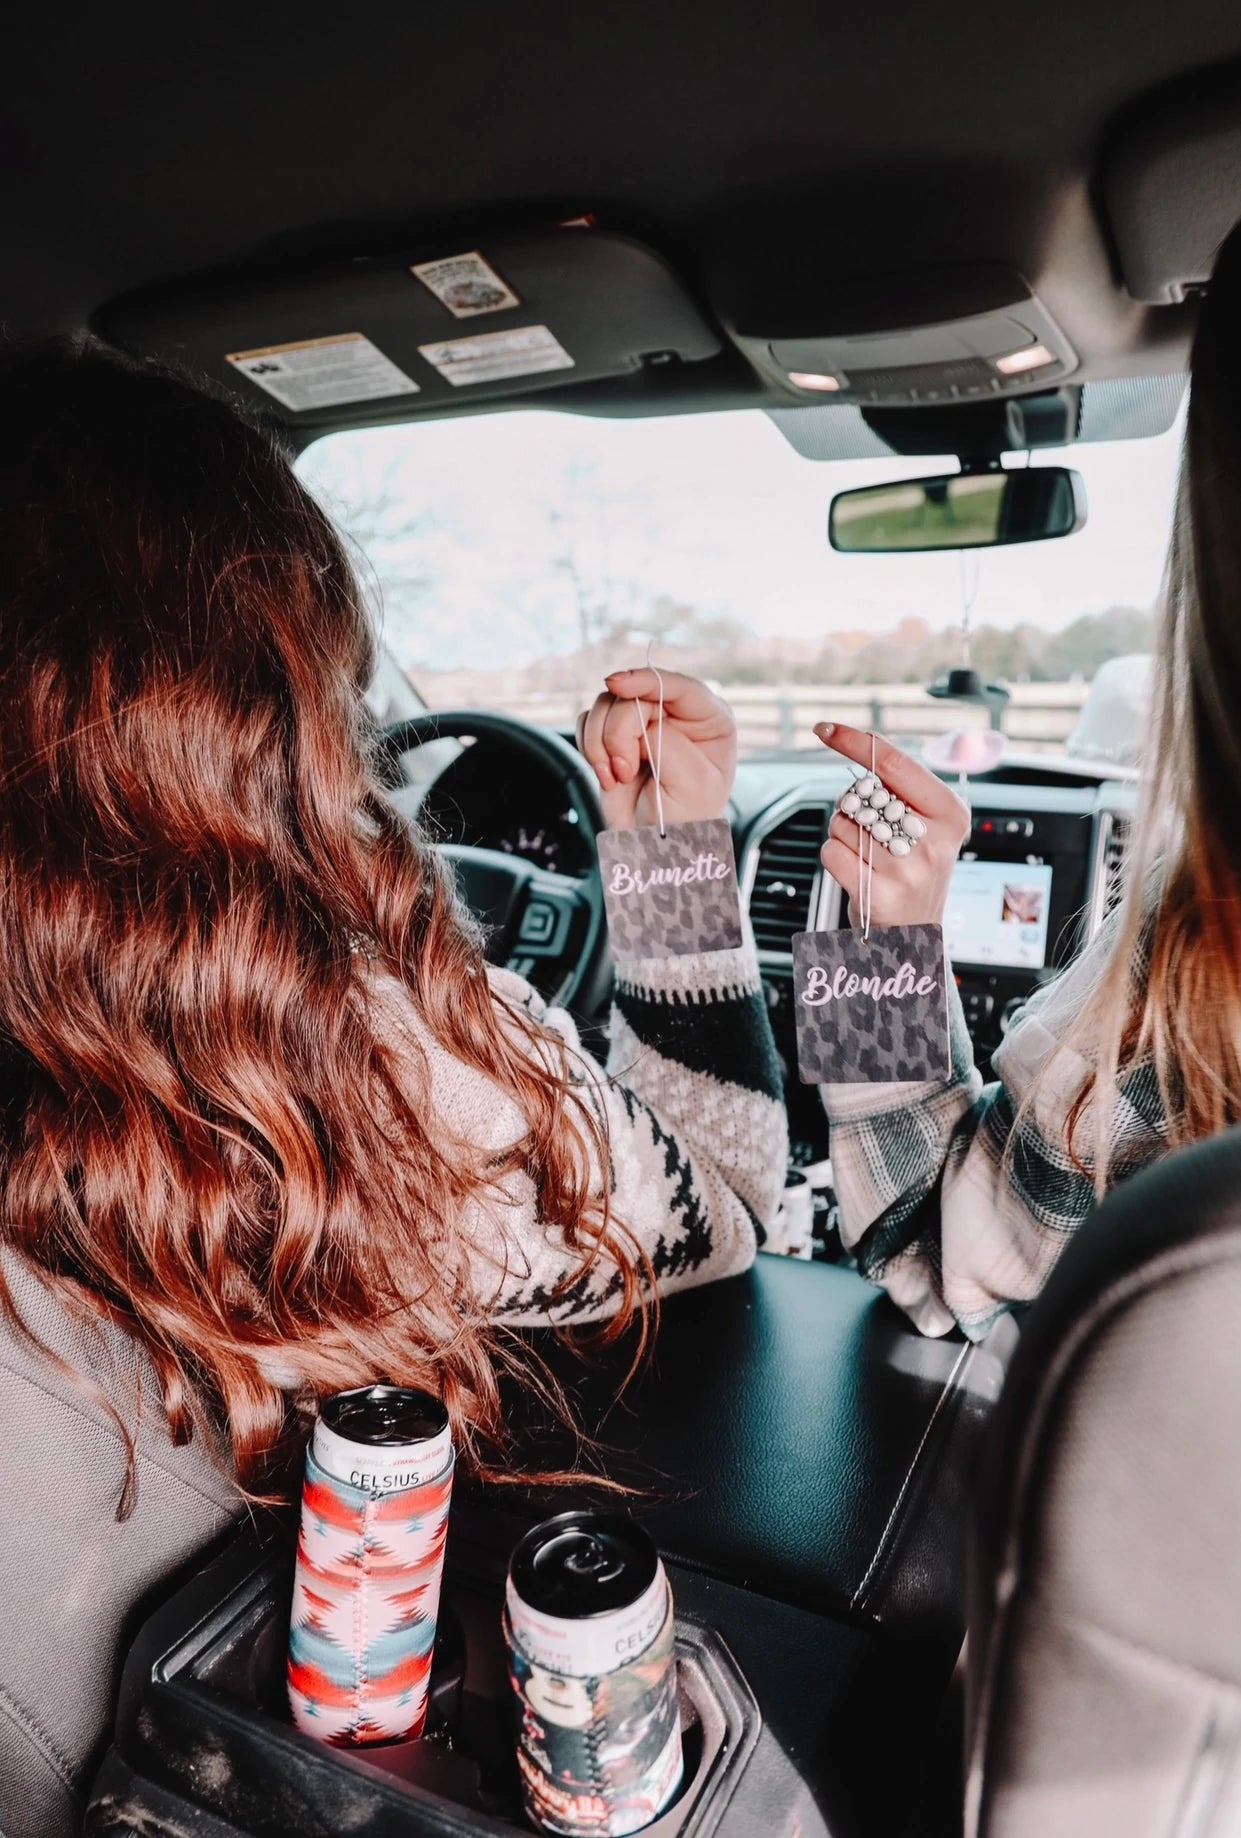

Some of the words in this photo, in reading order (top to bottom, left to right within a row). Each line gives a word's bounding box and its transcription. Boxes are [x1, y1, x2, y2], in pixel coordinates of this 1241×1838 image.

[609, 853, 732, 895] Brunette
[801, 962, 938, 1006] Blondie
[350, 1470, 419, 1488] CELSIUS
